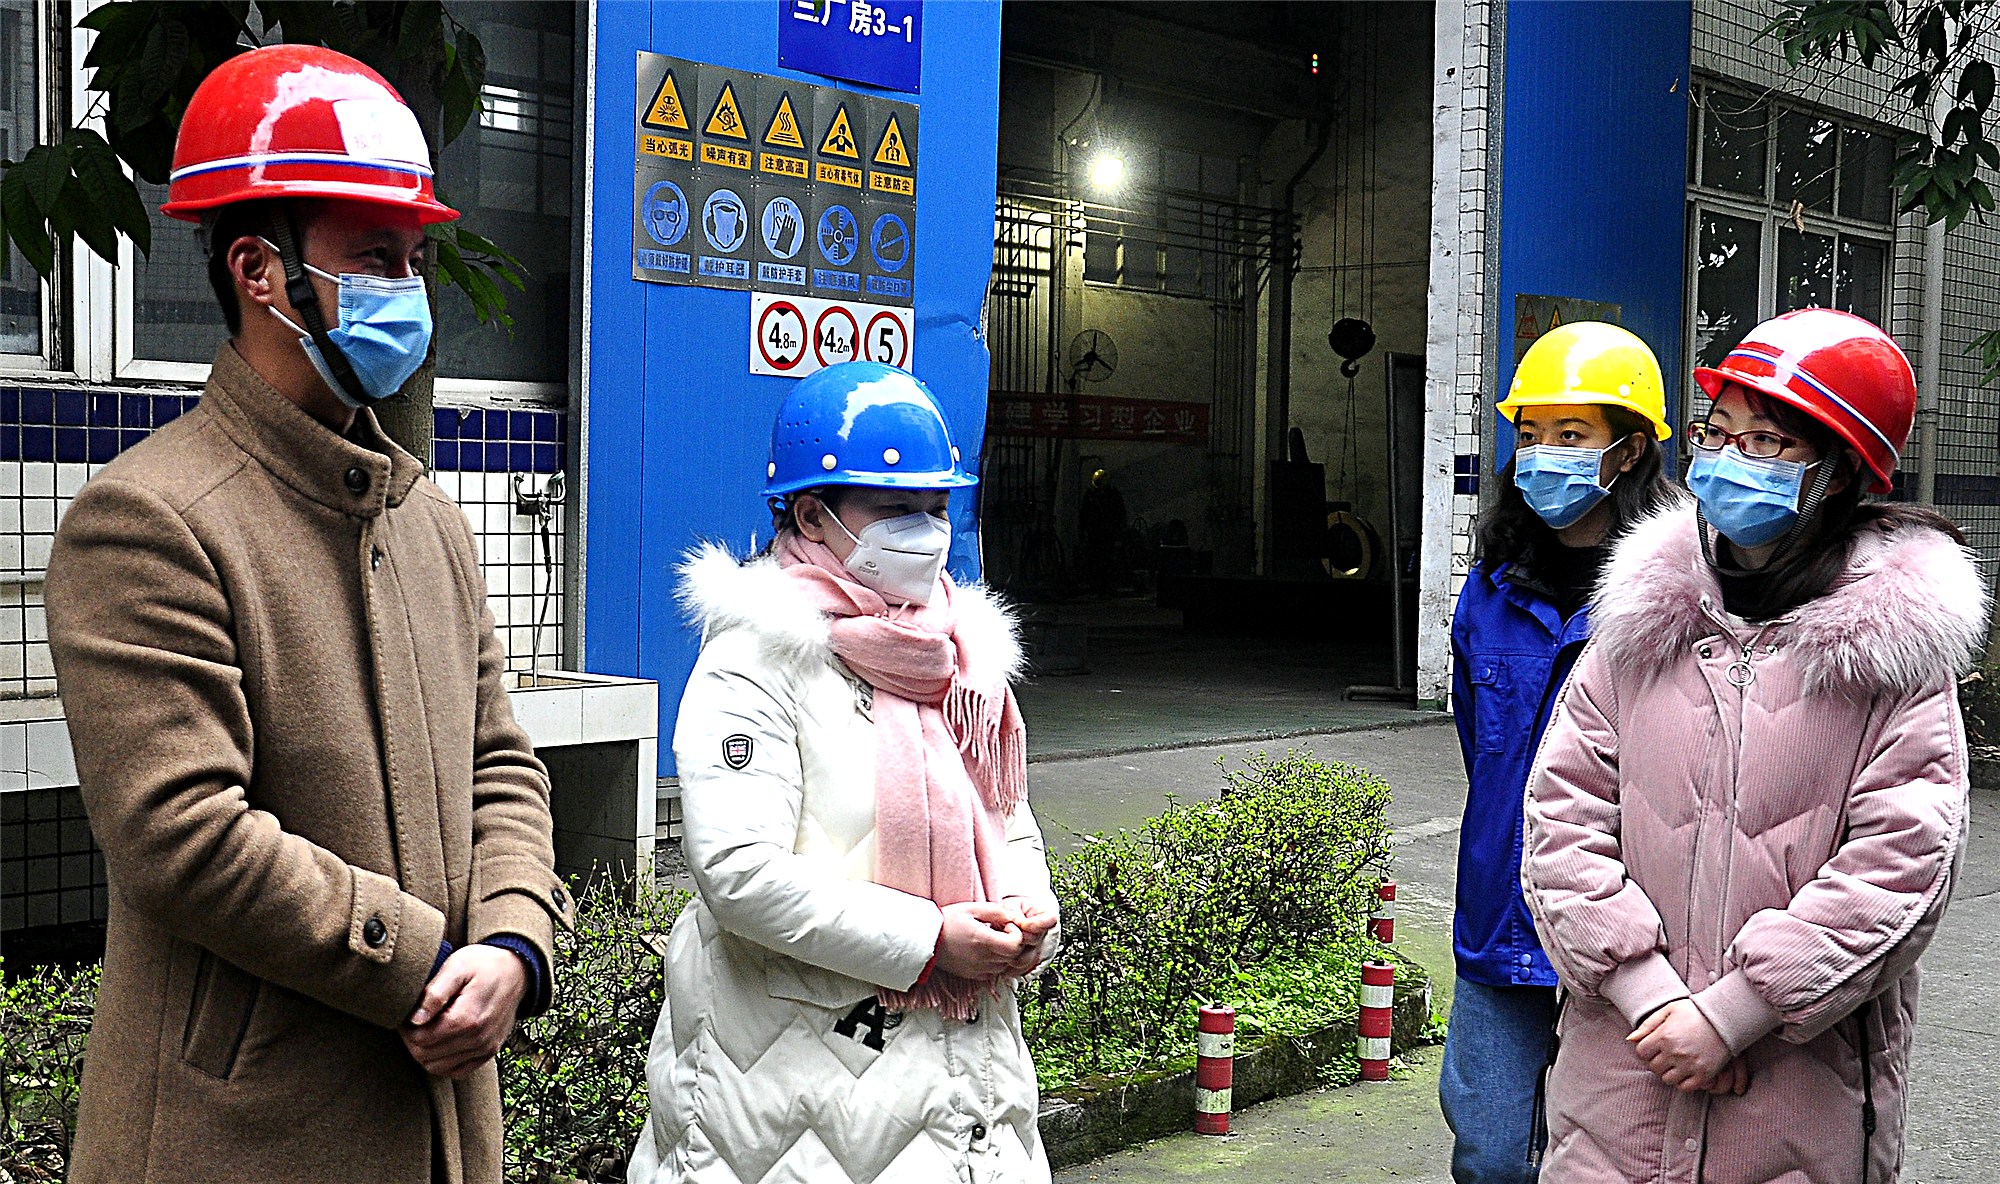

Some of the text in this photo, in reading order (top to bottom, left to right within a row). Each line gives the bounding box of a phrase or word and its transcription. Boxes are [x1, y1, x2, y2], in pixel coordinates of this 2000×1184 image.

[645, 138, 689, 158] 当心弧光
[706, 147, 748, 167] 噪声有害
[765, 156, 804, 175] 注意高温
[820, 167, 859, 184] 当心有毒气体
[874, 174, 910, 192] 注意防尘
[762, 265, 803, 282] 戴防护手套
[818, 272, 856, 288] 注意通风
[768, 322, 797, 349] 4.8m
[824, 327, 850, 354] 4.2m
[878, 328, 894, 364] 5
